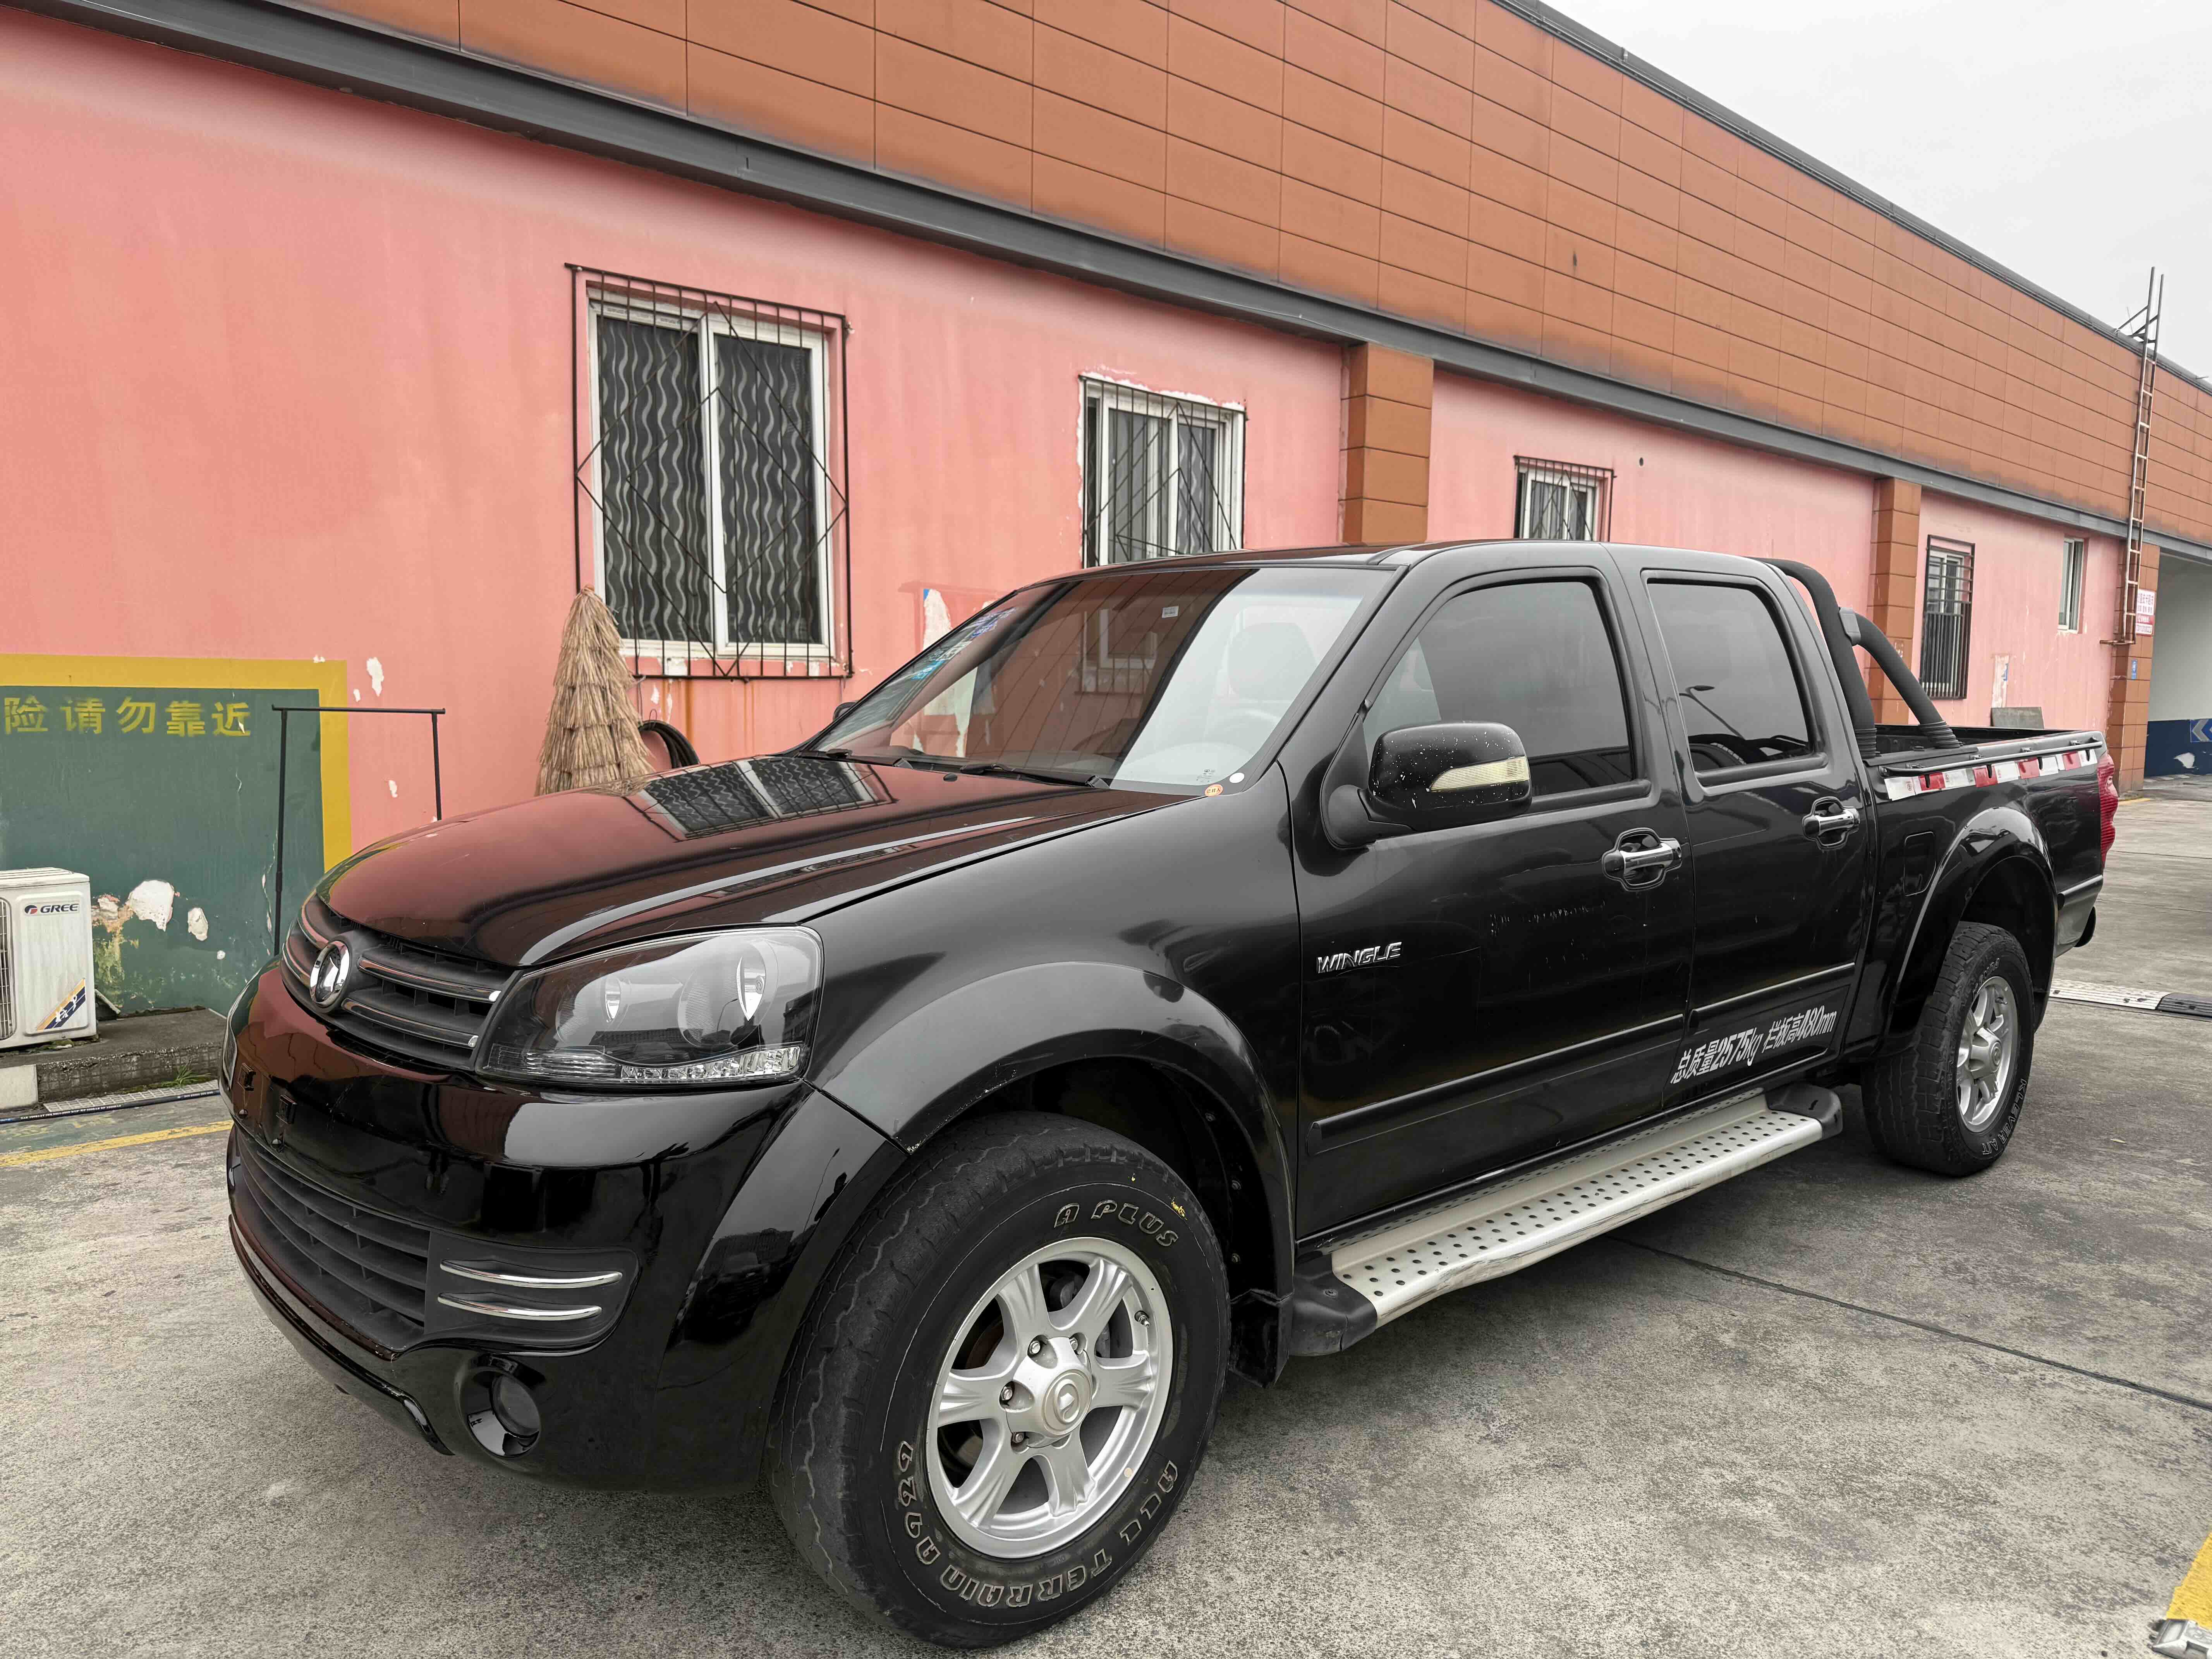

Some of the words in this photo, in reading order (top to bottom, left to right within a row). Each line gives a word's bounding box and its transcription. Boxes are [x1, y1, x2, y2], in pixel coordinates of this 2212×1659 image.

[4, 694, 250, 737] 险请勿靠近
[40, 903, 79, 913] GREE
[1317, 941, 1402, 974] WINGLE
[1670, 1027, 1764, 1084] 总质量2575kg
[1762, 1005, 1837, 1053] 栏板高480mm
[1998, 1078, 2027, 1144] KLEVER
[1054, 1202, 1080, 1228] A
[1090, 1199, 1179, 1247] PLUS
[898, 1440, 941, 1565] A929
[1119, 1460, 1178, 1546] ALL
[940, 1548, 1113, 1607] TERRAIN
